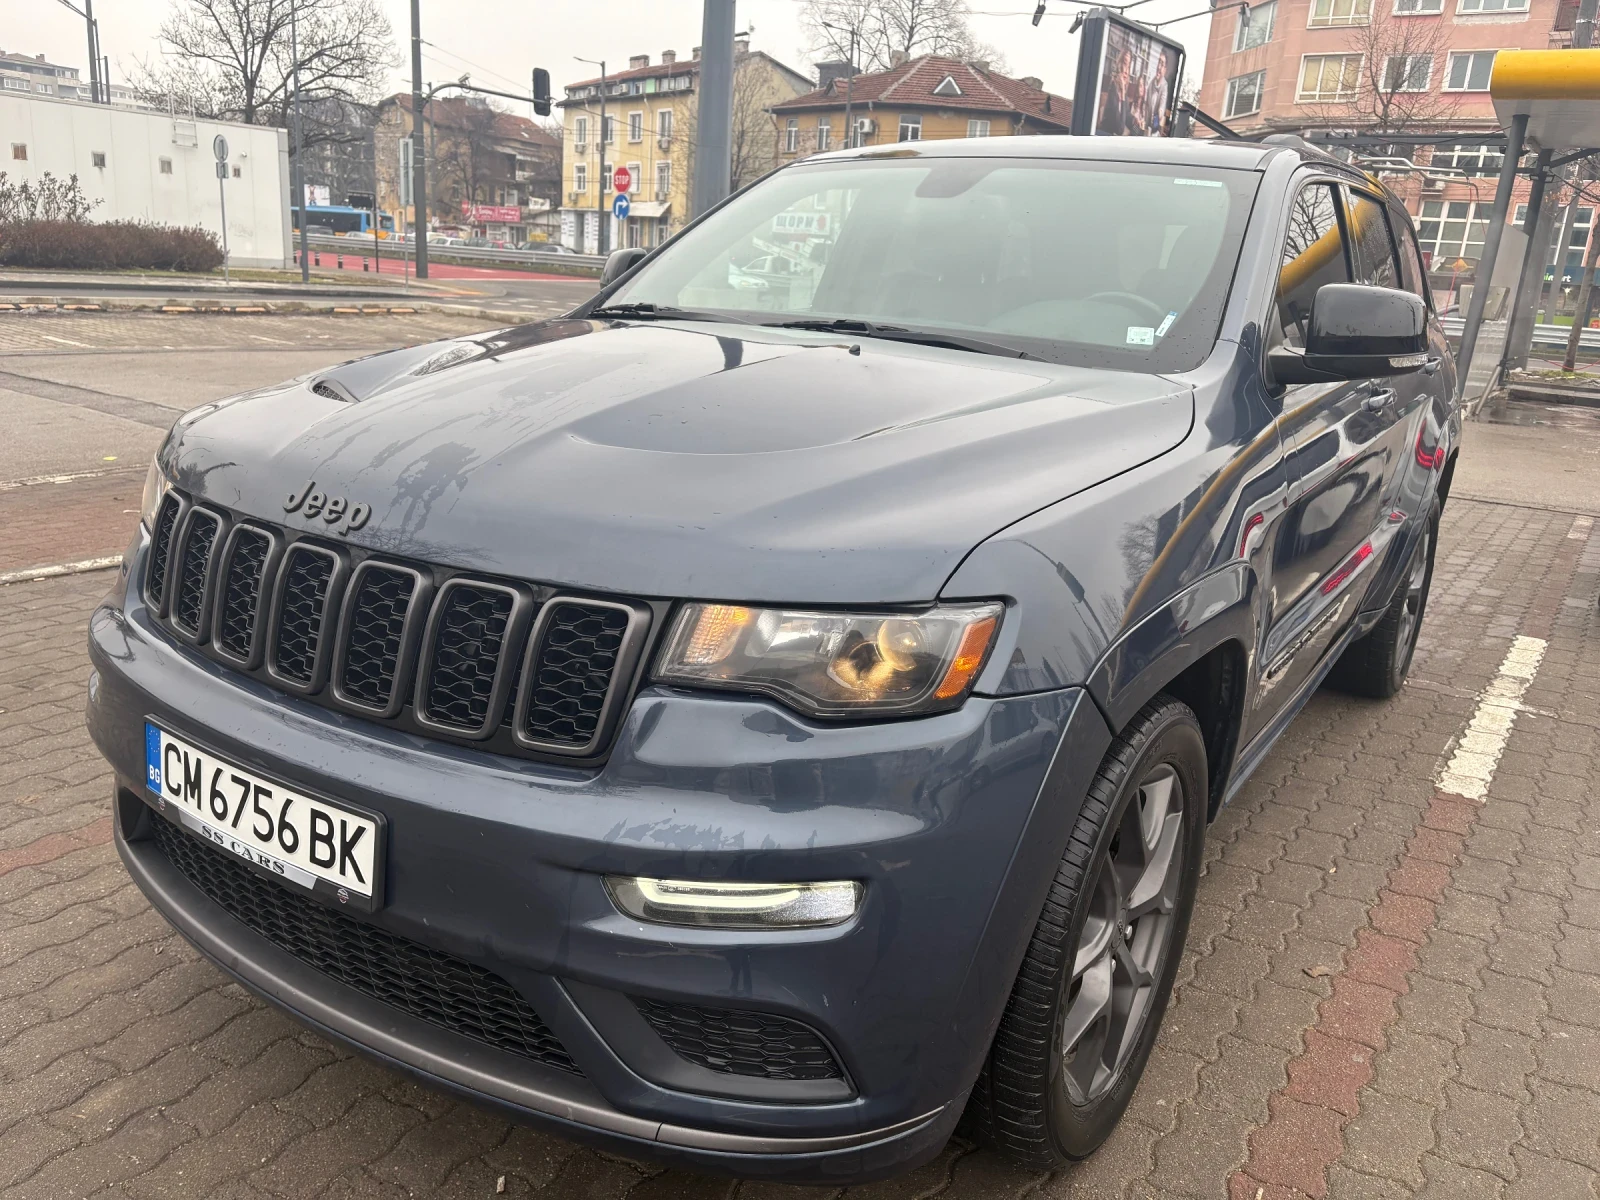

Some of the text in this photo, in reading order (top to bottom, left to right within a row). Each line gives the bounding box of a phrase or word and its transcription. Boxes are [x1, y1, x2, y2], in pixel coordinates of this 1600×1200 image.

[614, 174, 630, 185] STOP
[282, 479, 372, 537] Jeep
[149, 765, 161, 784] BG
[209, 767, 300, 854] 6756
[201, 825, 285, 875] SS CARS
